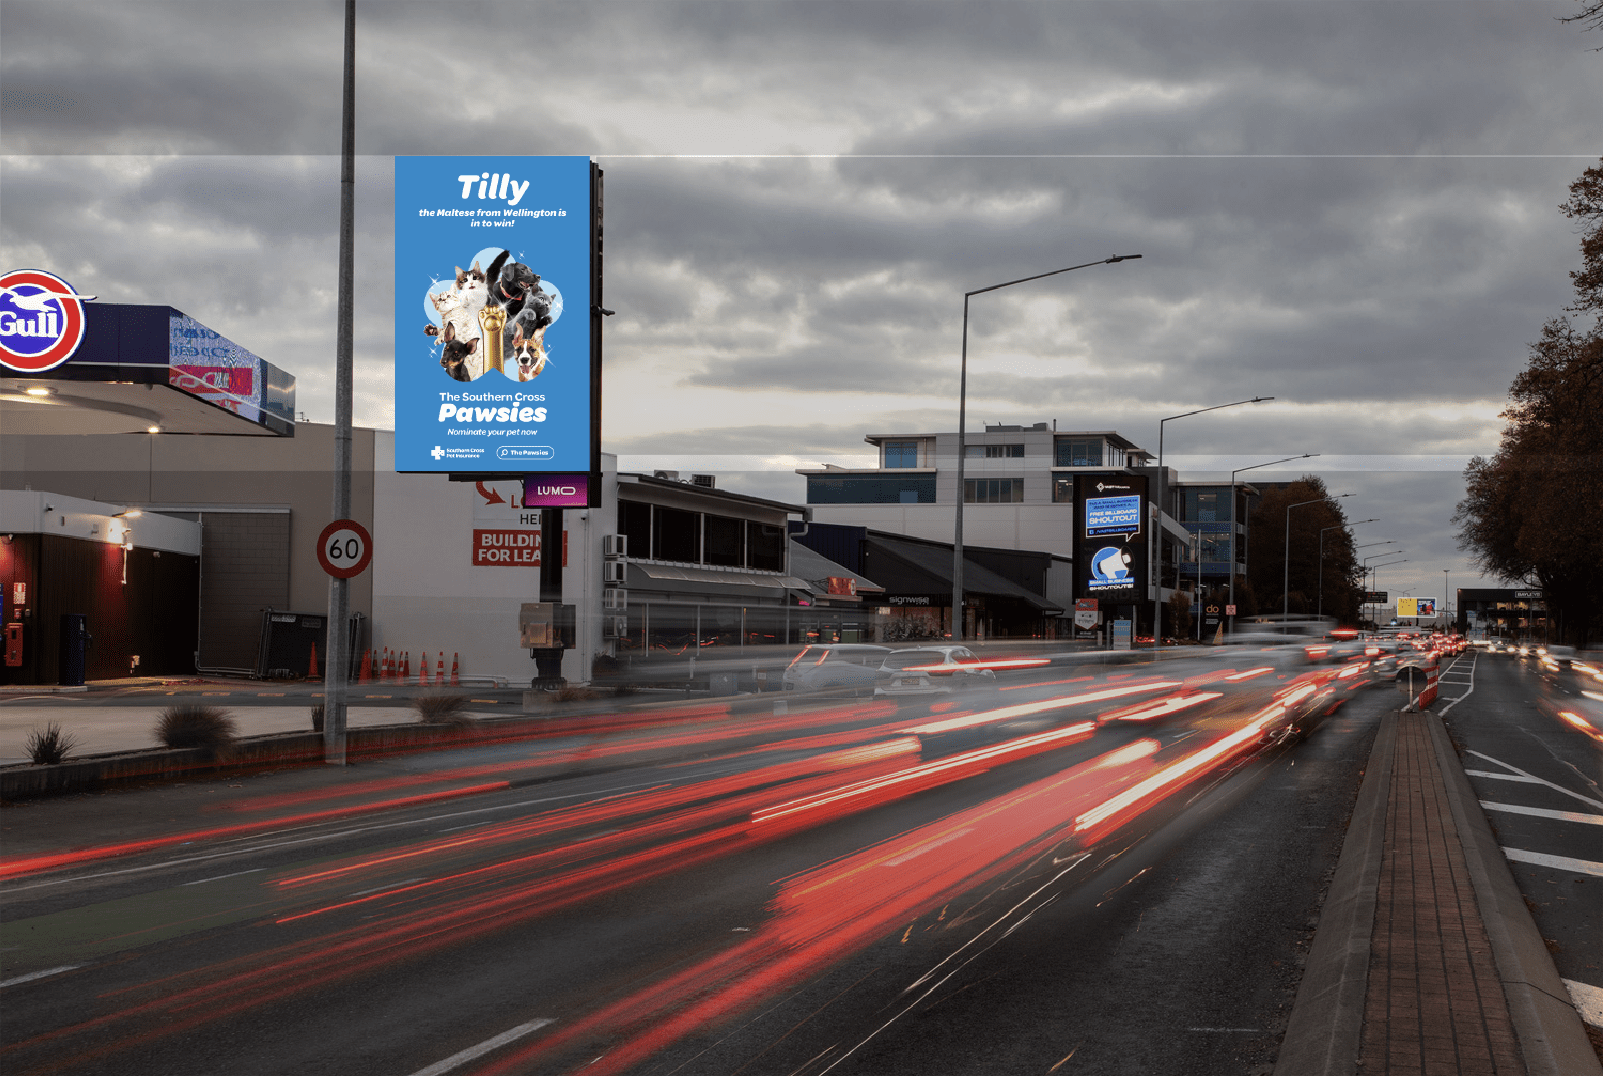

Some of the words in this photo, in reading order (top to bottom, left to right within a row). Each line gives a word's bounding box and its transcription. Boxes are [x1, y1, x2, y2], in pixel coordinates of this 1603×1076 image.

[458, 172, 530, 206] Tilly
[418, 209, 435, 217] the
[436, 209, 475, 217] Maltese
[476, 209, 501, 217] from
[503, 209, 556, 218] Wellington
[558, 209, 567, 217] is
[470, 219, 480, 227] in
[481, 219, 492, 227] to
[493, 219, 515, 227] win!
[0, 311, 59, 338] Gull
[439, 392, 460, 402] The
[462, 392, 513, 402] Southern
[514, 392, 546, 402] Cross
[438, 402, 548, 422] Pawsies
[447, 428, 486, 436] Nominate
[487, 429, 505, 437] your
[506, 429, 520, 437] pet
[537, 486, 577, 496] LUMO
[520, 513, 541, 525] HE
[1089, 515, 1137, 525] SHOUTOUT
[481, 533, 541, 547] BUILDIN
[330, 539, 358, 559] 60
[478, 549, 510, 562] FOR
[514, 549, 541, 562] LEA
[1206, 604, 1220, 613] do
